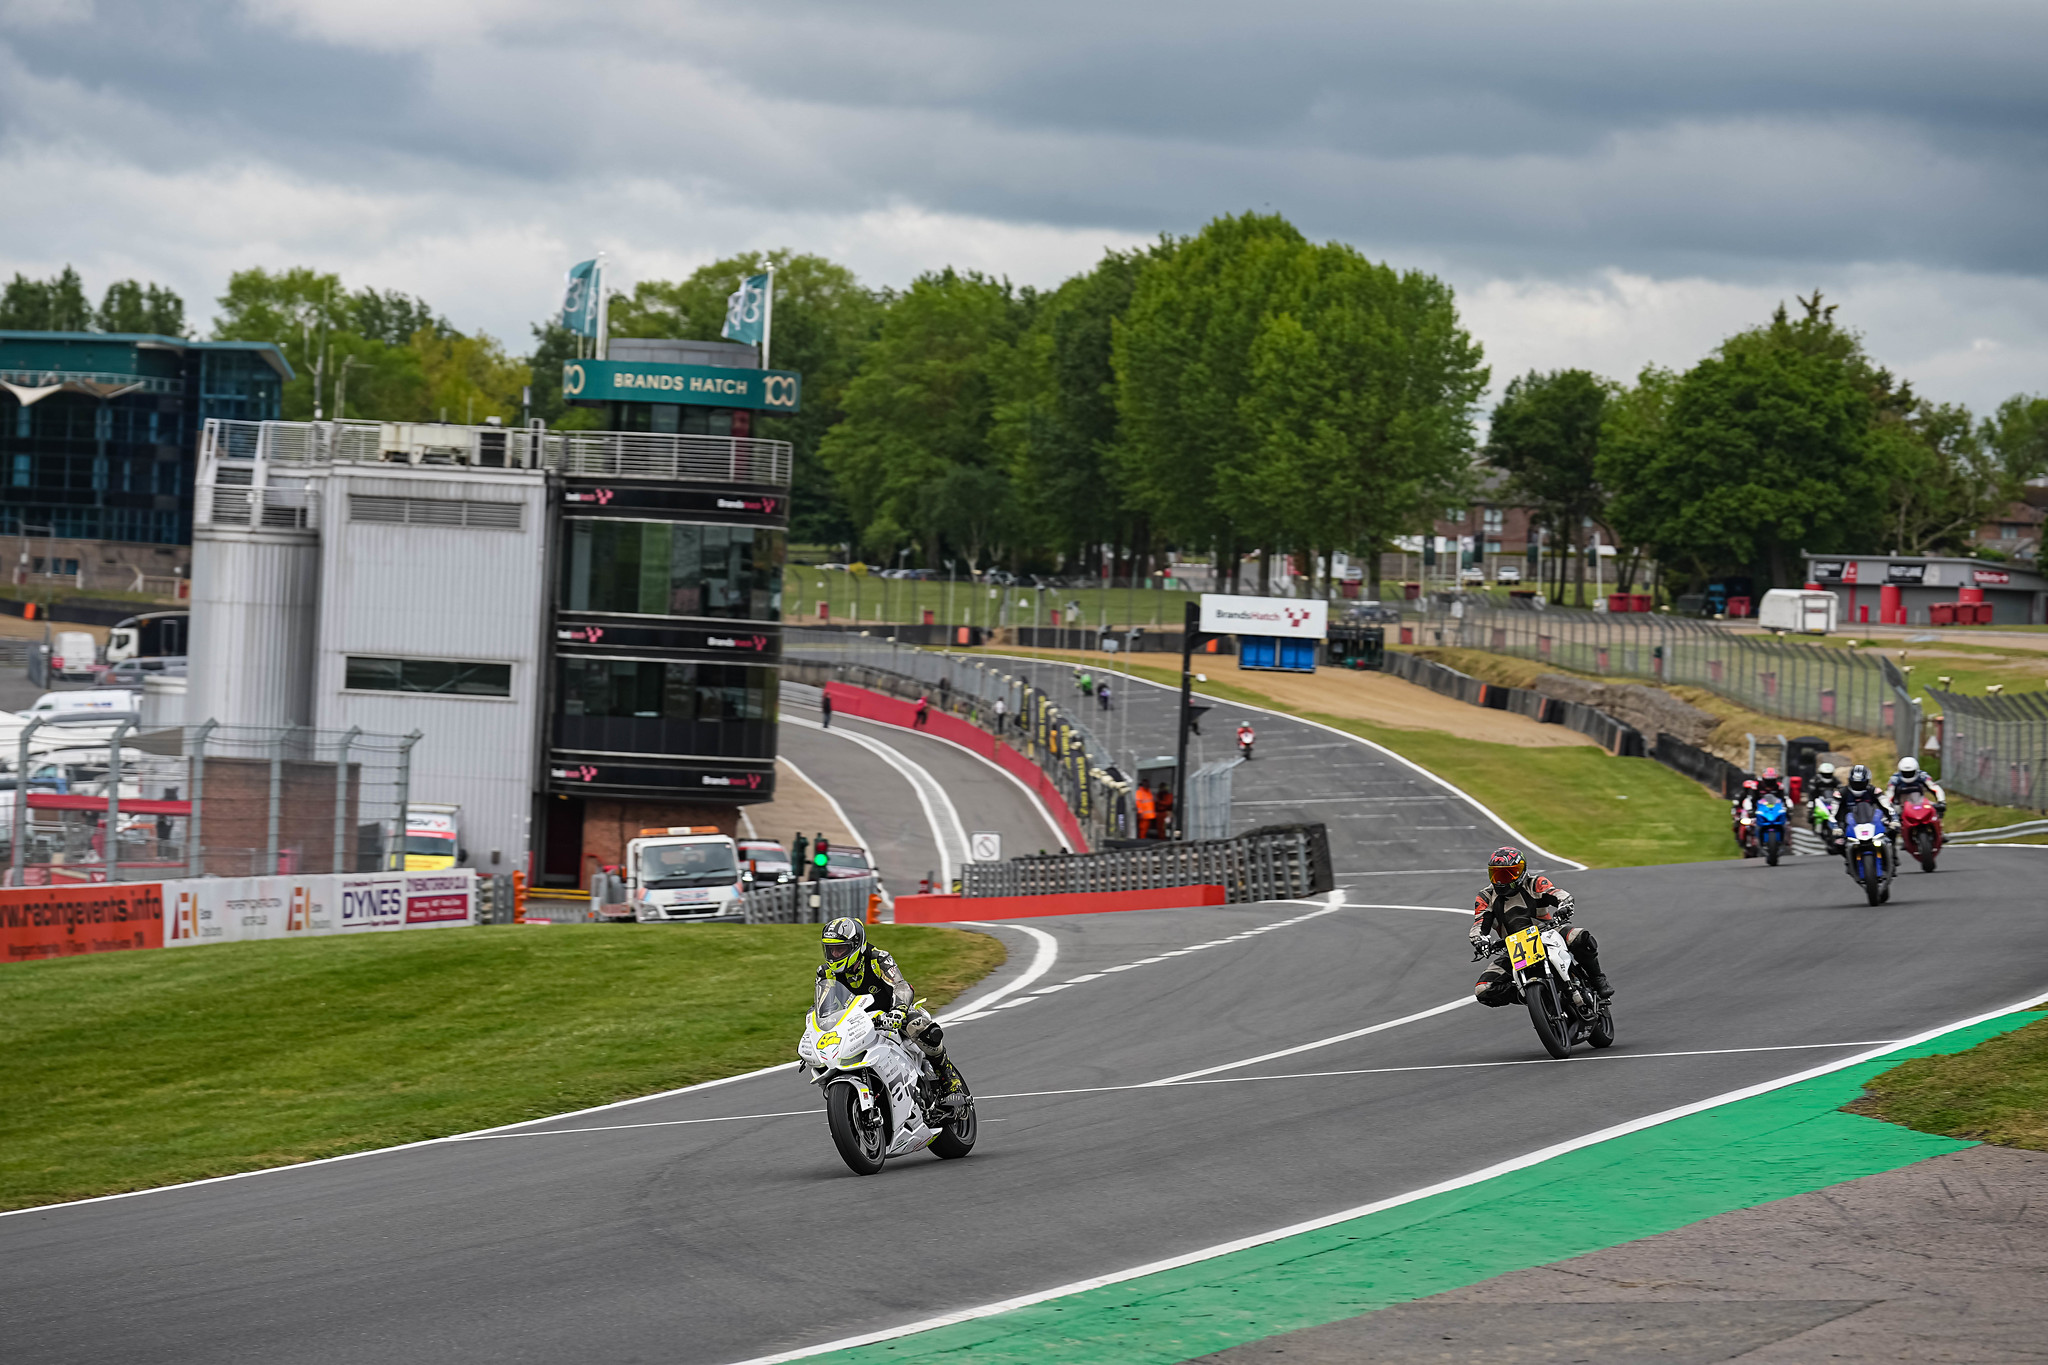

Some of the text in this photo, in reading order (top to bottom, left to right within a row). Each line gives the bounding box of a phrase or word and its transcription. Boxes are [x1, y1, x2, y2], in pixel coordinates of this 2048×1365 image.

[613, 372, 748, 395] BRANDS HATCH
[762, 375, 797, 408] 100
[1215, 608, 1281, 622] BrandsHatch
[343, 888, 401, 919] DYNES
[1512, 934, 1539, 960] 47
